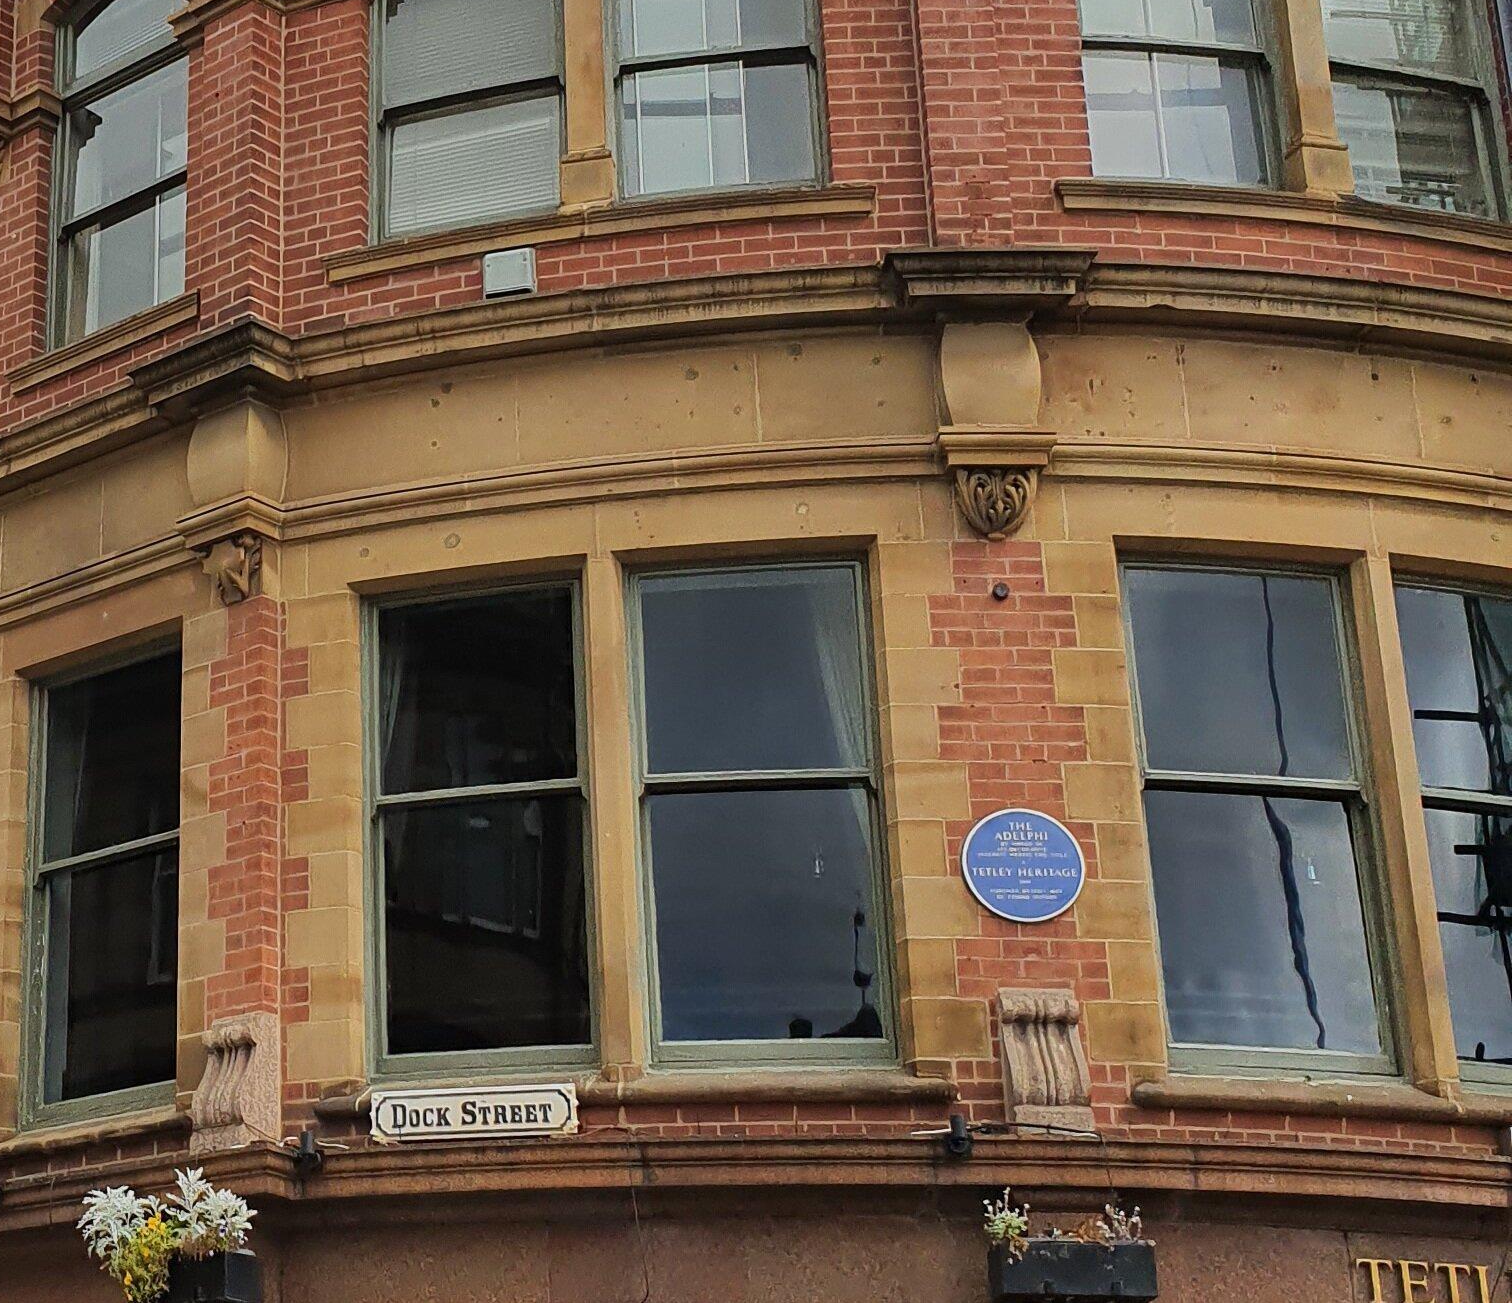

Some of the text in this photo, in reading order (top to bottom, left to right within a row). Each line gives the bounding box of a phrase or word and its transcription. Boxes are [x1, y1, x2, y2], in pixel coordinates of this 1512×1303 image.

[995, 831, 1048, 841] ADELPHI
[972, 867, 1078, 878] TETLEY HERITAGE
